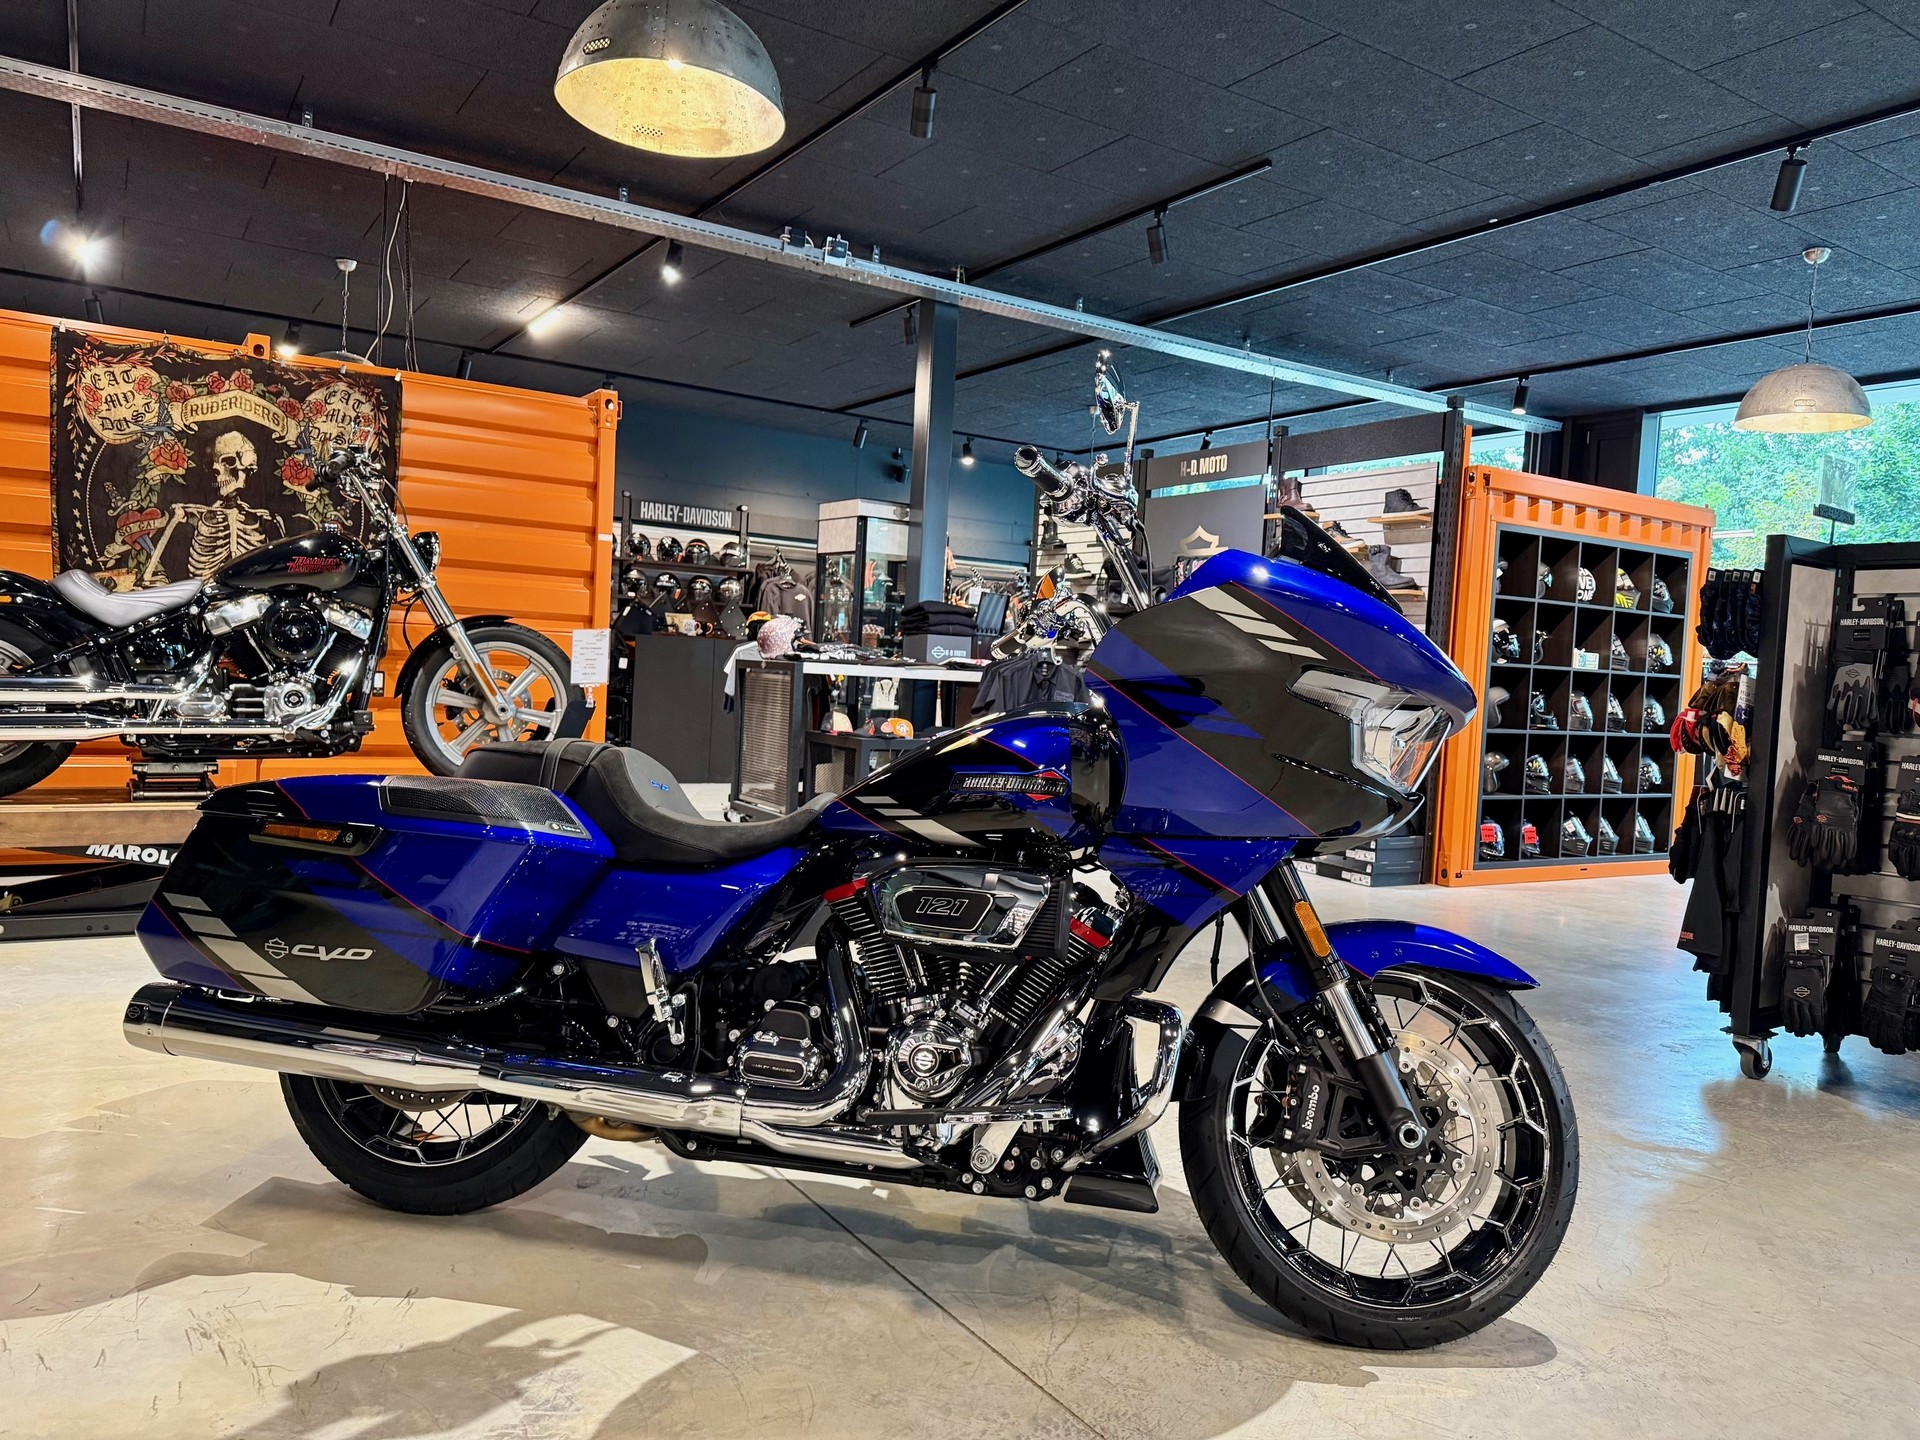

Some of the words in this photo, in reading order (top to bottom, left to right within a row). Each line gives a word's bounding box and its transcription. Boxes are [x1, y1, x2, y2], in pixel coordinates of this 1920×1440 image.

[90, 366, 136, 391] EAT
[104, 390, 136, 412] MY
[190, 396, 281, 427] RUDERIDERS
[324, 387, 368, 414] EAT
[98, 401, 156, 432] DUST
[321, 408, 353, 431] MY
[308, 425, 354, 446] DUS
[640, 501, 733, 530] HARLEY-DAVIDSON
[119, 526, 132, 537] SO
[1840, 618, 1885, 626] HARLEY-DAVIDSON
[1817, 754, 1865, 767] HARLEY-DAVIDSON
[85, 843, 178, 866] MAROL
[916, 896, 969, 917] 121
[1788, 924, 1835, 934] HARLEY-DAVIDSON
[291, 944, 374, 961] CVO
[1302, 1084, 1320, 1130] brembo
